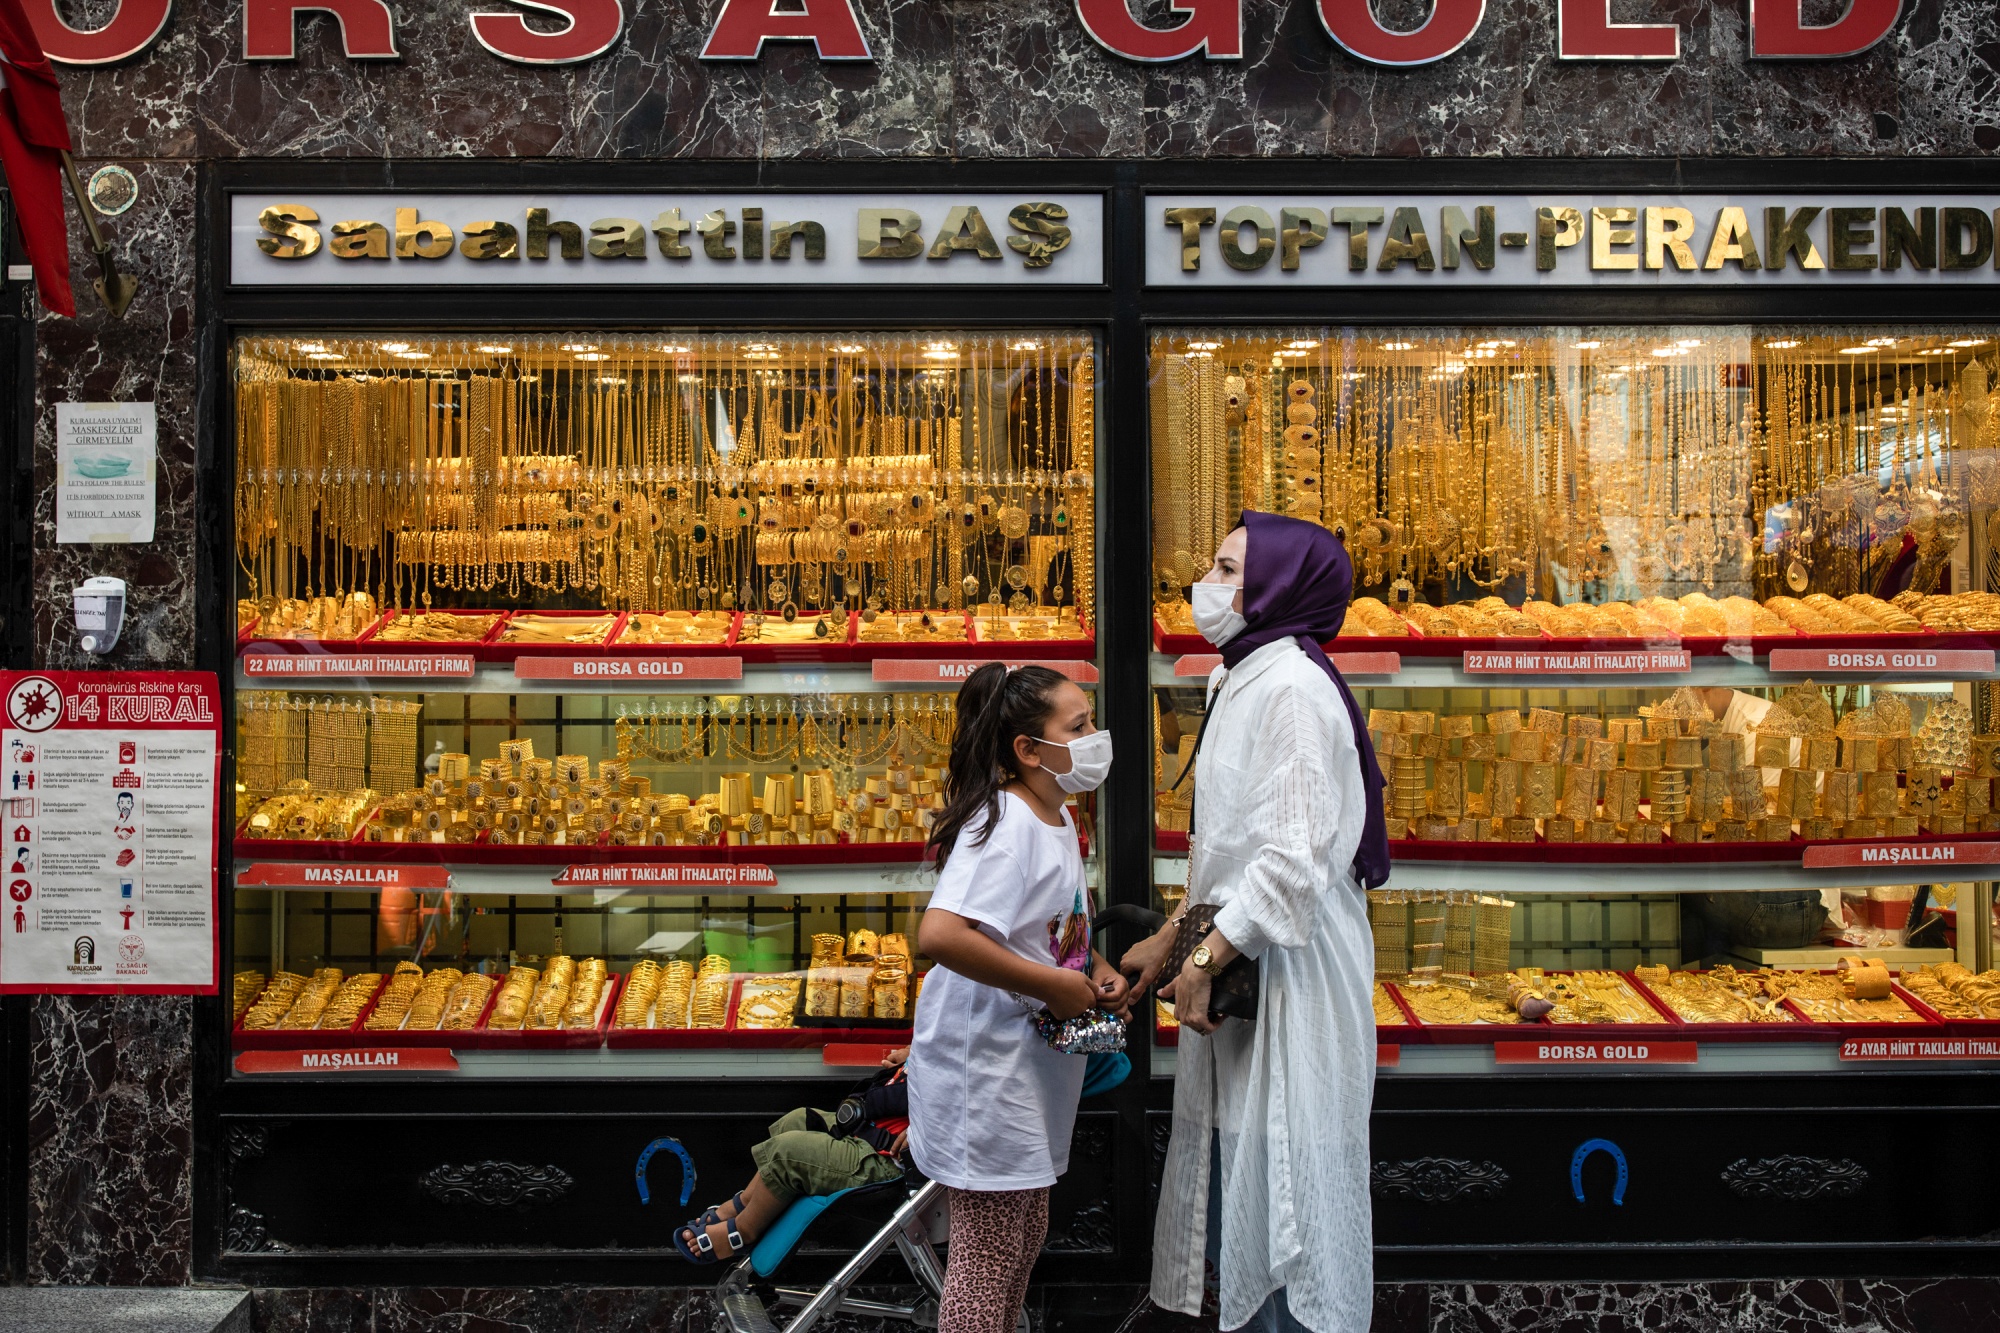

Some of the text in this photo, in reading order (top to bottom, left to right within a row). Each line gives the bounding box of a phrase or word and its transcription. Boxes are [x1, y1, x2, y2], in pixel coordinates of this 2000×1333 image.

[255, 202, 1070, 269] Sabahattin BAŞ
[1164, 205, 2000, 272] TOPTAN-PERAKEND
[72, 425, 143, 434] MASKESİZ İÇERİ
[76, 436, 133, 444] GİRMEYELİM
[249, 657, 470, 675] 22 AYAR HİNT TAKILARI İTHALATÇI FİRMA
[573, 661, 684, 676] BORSA GOLD
[1469, 653, 1686, 671] 22 AYAR HİNT TAKILARI İTHALATÇI FİRMA
[1828, 653, 1937, 668] BORSA GOLD
[78, 681, 203, 696] Koronavirüs Riskine Karşı
[66, 694, 214, 723] 14 KURAL
[1862, 846, 1955, 864] MAŞALLAH
[305, 868, 399, 885] MAŞALLAH
[572, 869, 599, 881] AYAR
[602, 866, 627, 881] HİNT
[631, 869, 678, 881] TAKILARI
[682, 866, 736, 884] İTHALATÇI
[740, 867, 774, 881] FİRMA
[1538, 1045, 1649, 1060] BORSA GOLD
[1844, 1040, 2000, 1056] 22 AYAR HİNT TAKILARI İTHAL
[303, 1052, 398, 1069] MAŞALLAH
